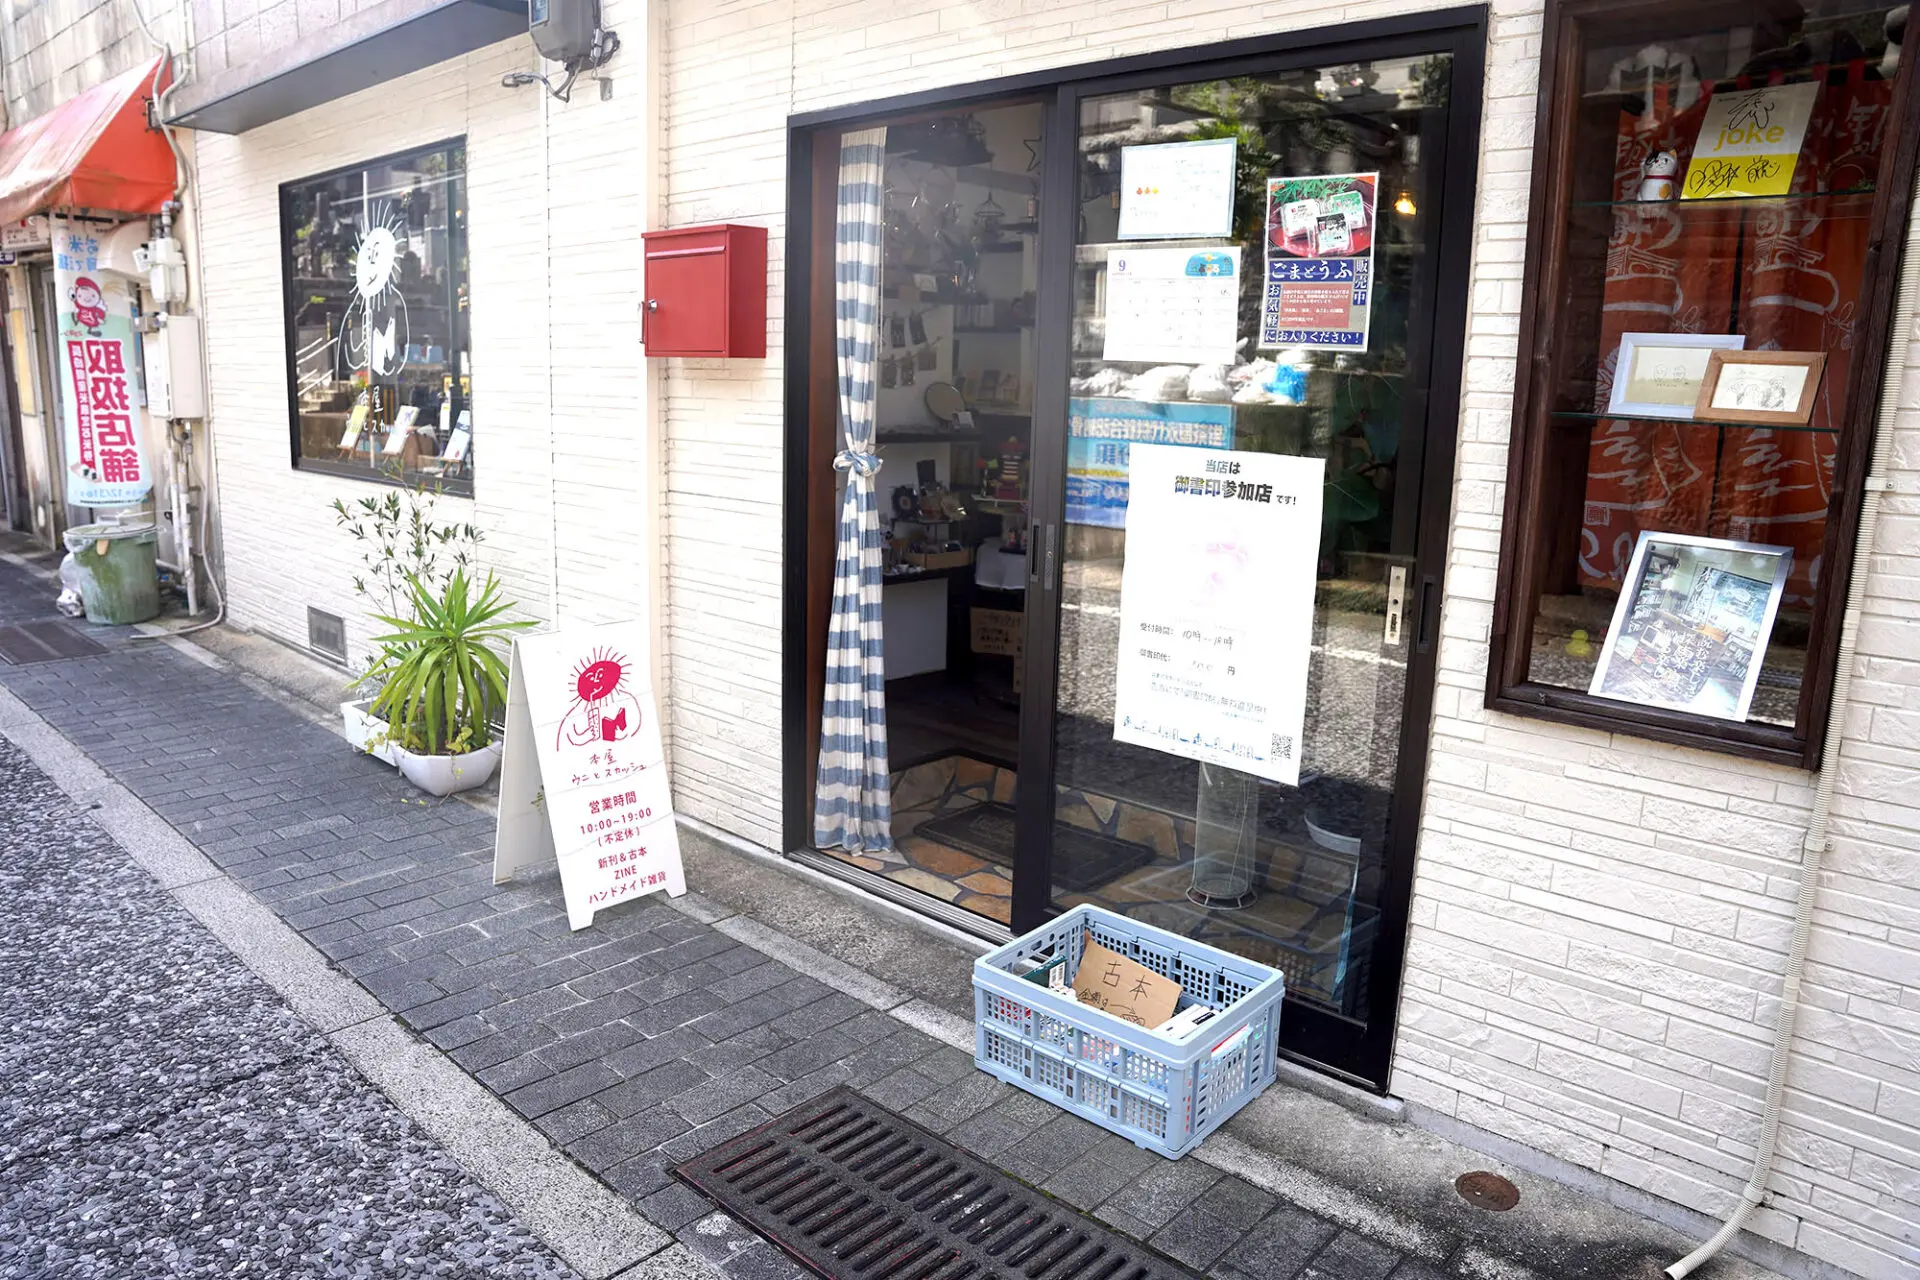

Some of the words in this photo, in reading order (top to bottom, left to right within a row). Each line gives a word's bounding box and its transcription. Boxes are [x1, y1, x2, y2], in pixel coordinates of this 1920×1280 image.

[1712, 121, 1785, 153] joke
[1118, 259, 1127, 273] 9
[1272, 260, 1353, 280] ごまどうふ
[1353, 259, 1369, 305] 販売中
[1265, 284, 1281, 342] お気軽に
[1205, 459, 1240, 475] 当店は
[589, 749, 617, 766] 本屋
[588, 790, 637, 816] 営業時間
[597, 846, 648, 870] 新刊&古本
[613, 864, 638, 881] ZINE
[588, 871, 667, 905] ハンドメイド雑貨
[1103, 960, 1152, 1001] 古本
